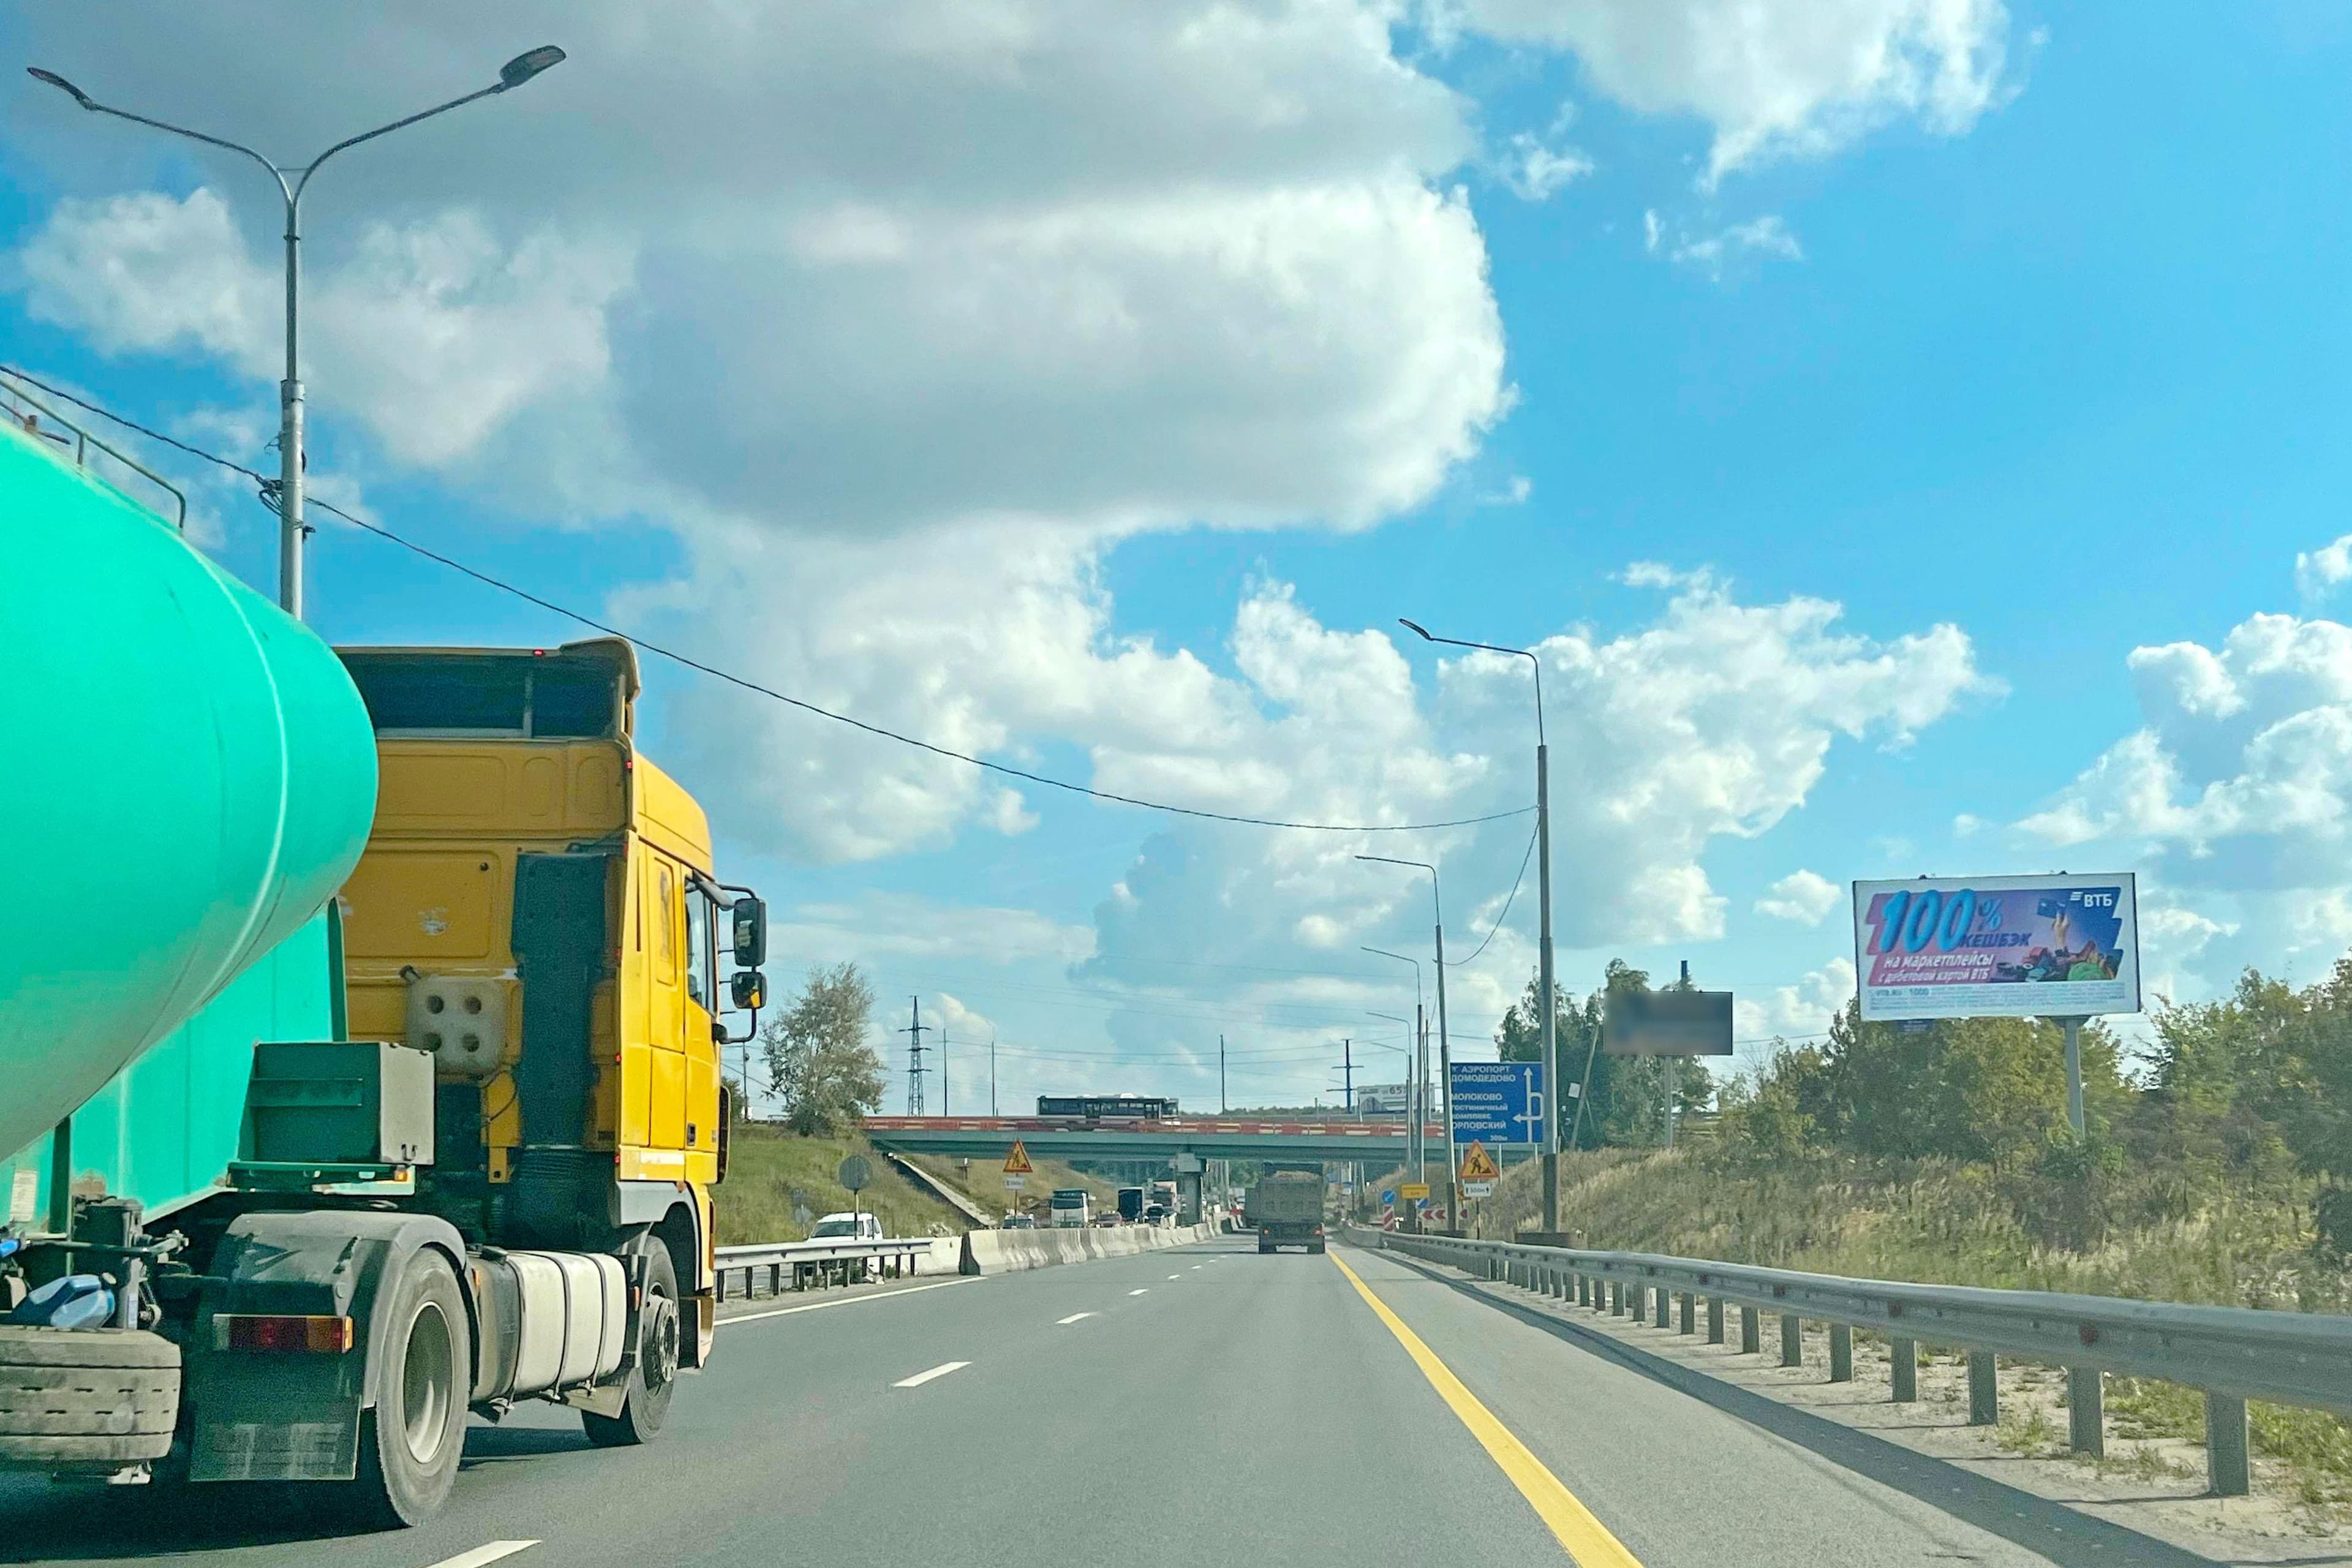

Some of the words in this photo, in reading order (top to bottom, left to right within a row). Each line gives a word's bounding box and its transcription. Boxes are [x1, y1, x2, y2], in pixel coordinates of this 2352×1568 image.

[2084, 892, 2112, 907] ВТБ
[1959, 932, 2033, 948] КЕШБЭК
[1883, 956, 1899, 968] на
[1902, 952, 1994, 970] маркетплейсы
[1885, 971, 1936, 984] дебетовой
[1937, 970, 1970, 983] картой
[1970, 968, 1990, 979] ВТБ
[1452, 1074, 1516, 1083] ДОМОДЕДОВО
